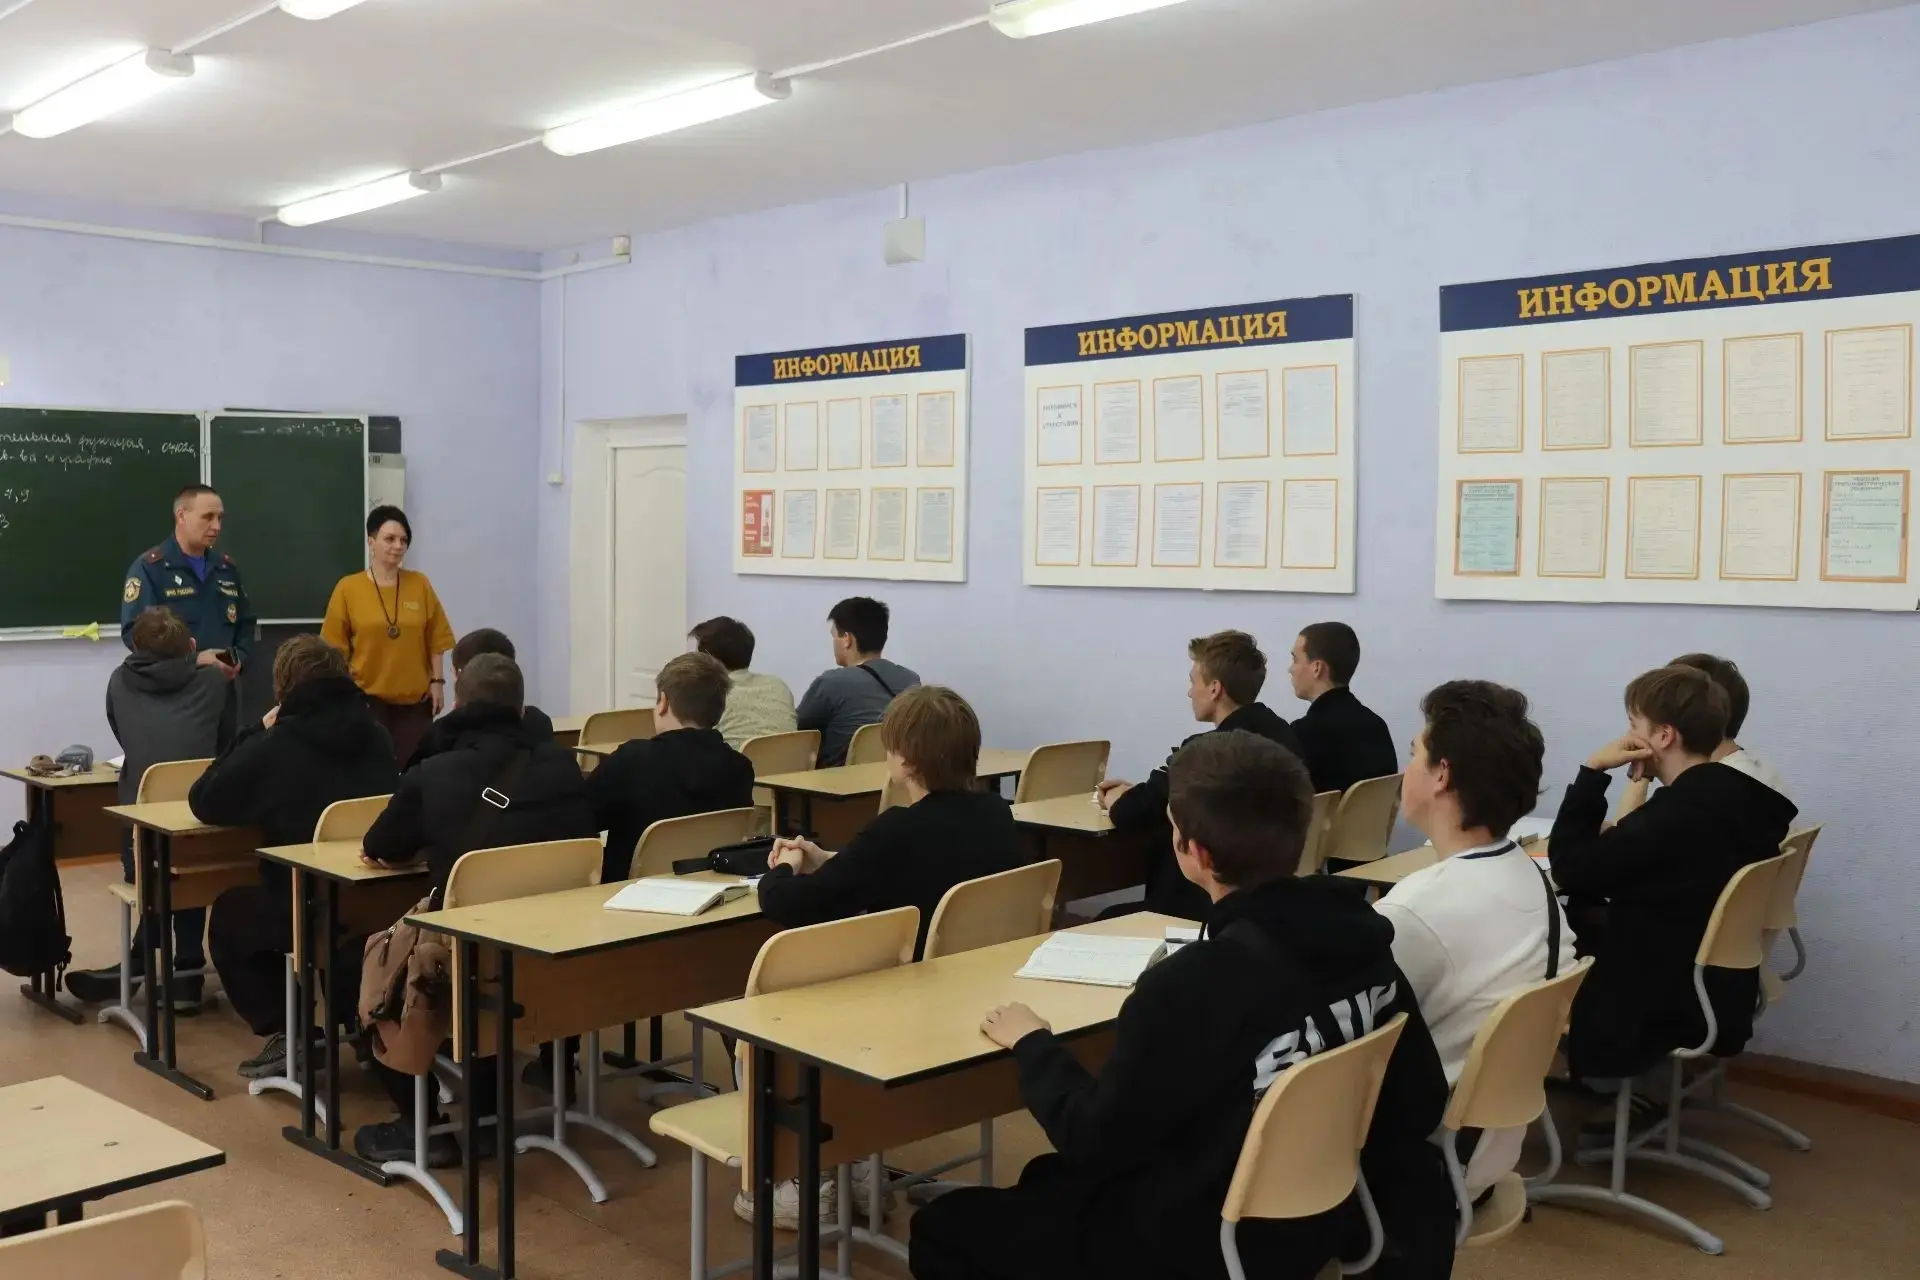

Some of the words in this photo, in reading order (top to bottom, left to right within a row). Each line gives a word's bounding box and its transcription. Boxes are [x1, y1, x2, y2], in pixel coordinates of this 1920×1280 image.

[1518, 257, 1832, 318] ИНФОРМАЦИЯ
[1078, 310, 1287, 356] ИНФОРМАЦИЯ
[773, 345, 921, 379] ИНФОРМАЦИЯ
